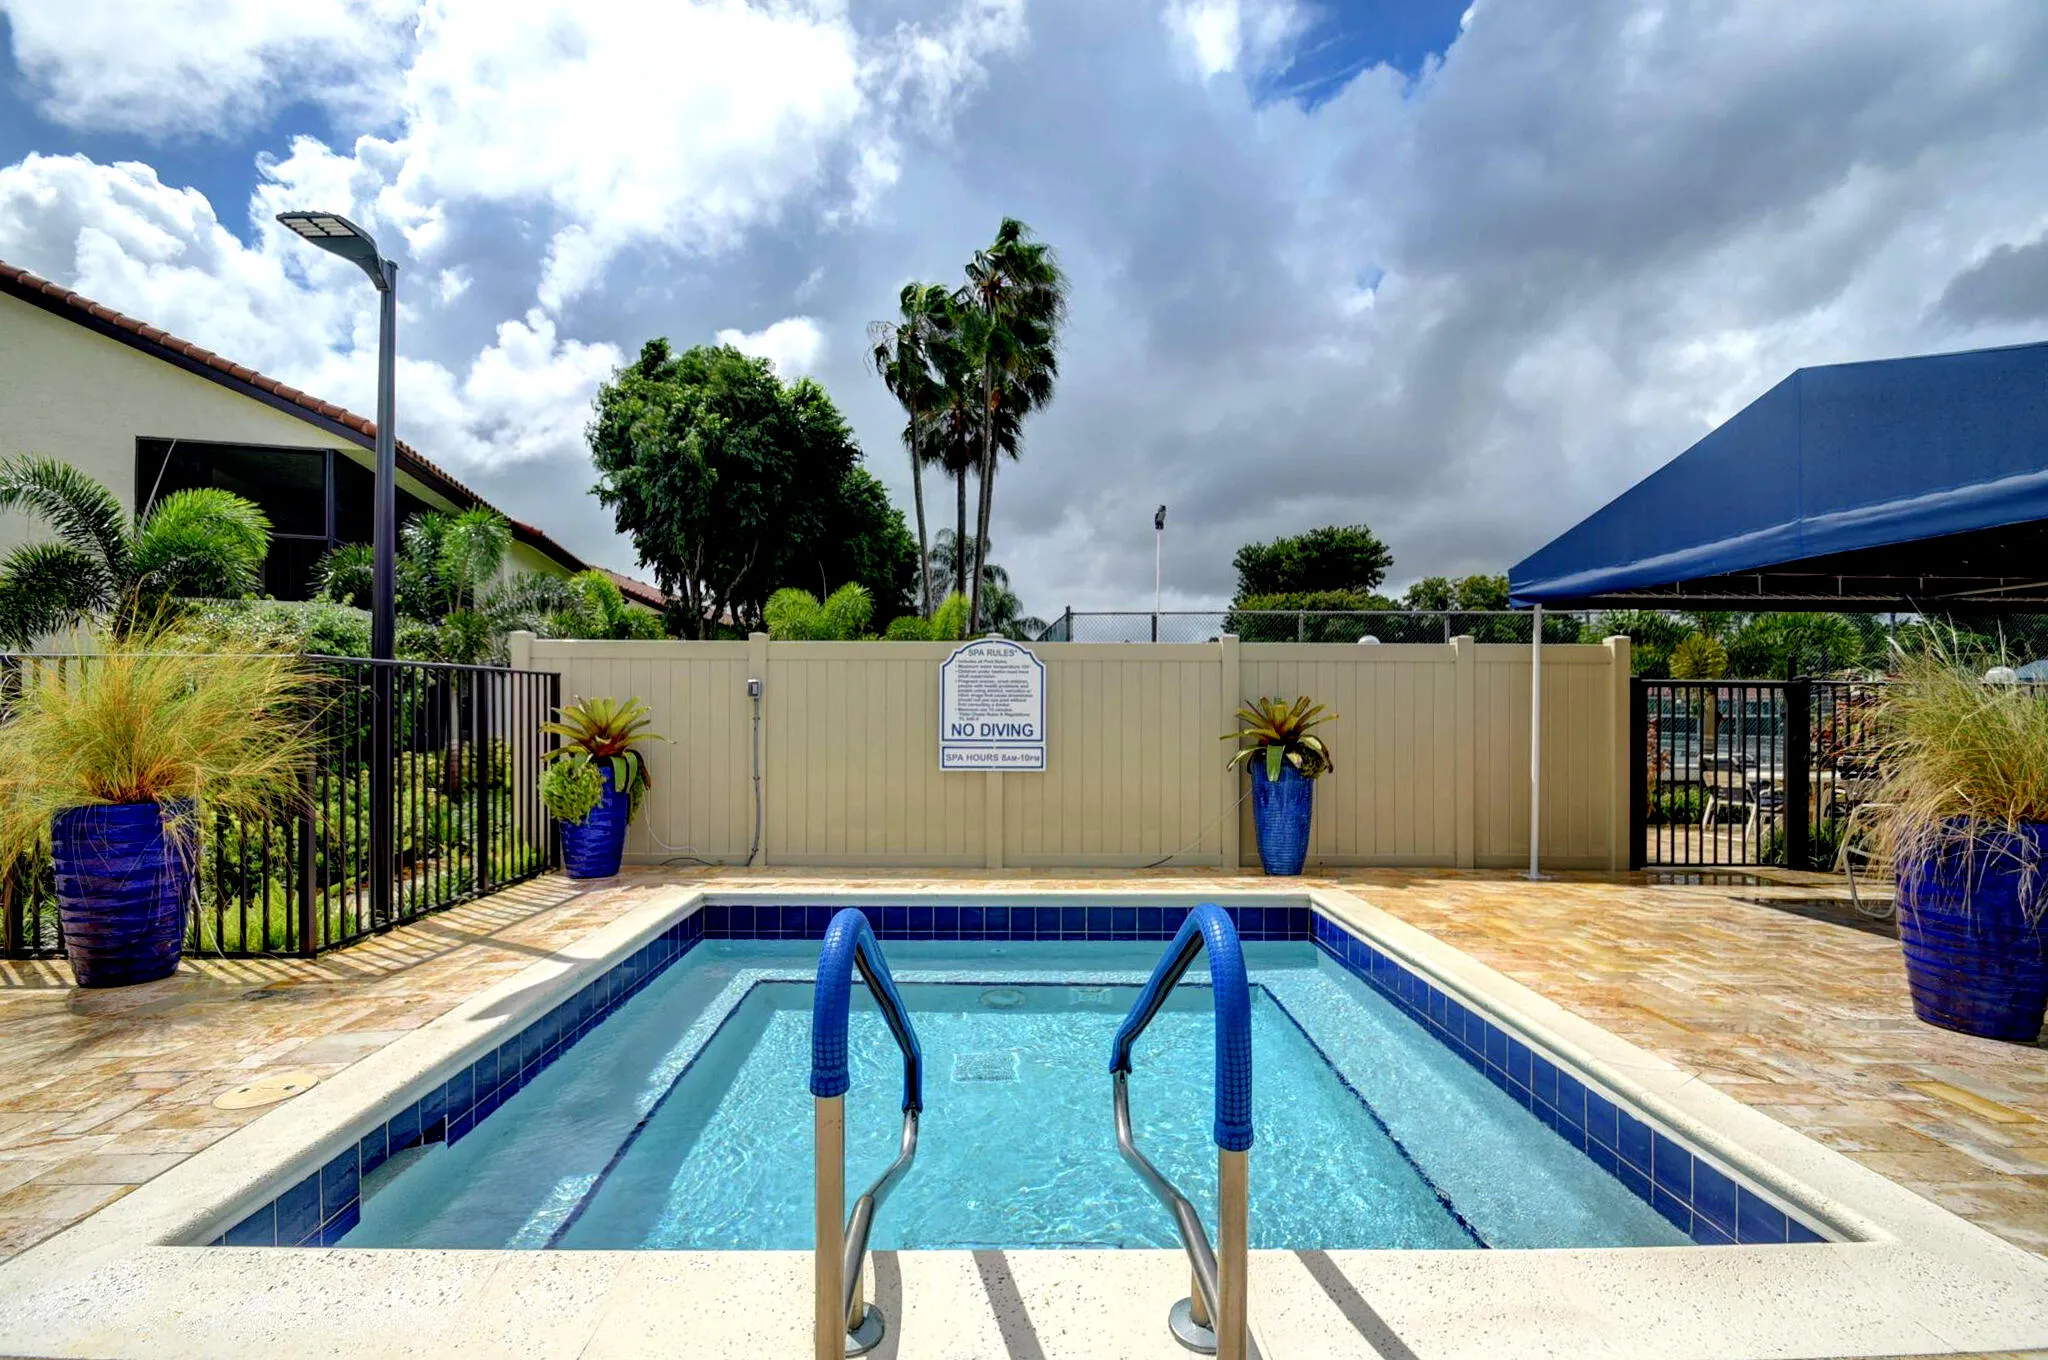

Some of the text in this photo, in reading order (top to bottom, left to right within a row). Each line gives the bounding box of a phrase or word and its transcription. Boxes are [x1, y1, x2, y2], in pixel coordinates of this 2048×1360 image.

[968, 648, 984, 656] SPA
[951, 723, 1034, 737] NO DIVING
[946, 754, 964, 762] SPA
[966, 754, 999, 762] HOURS
